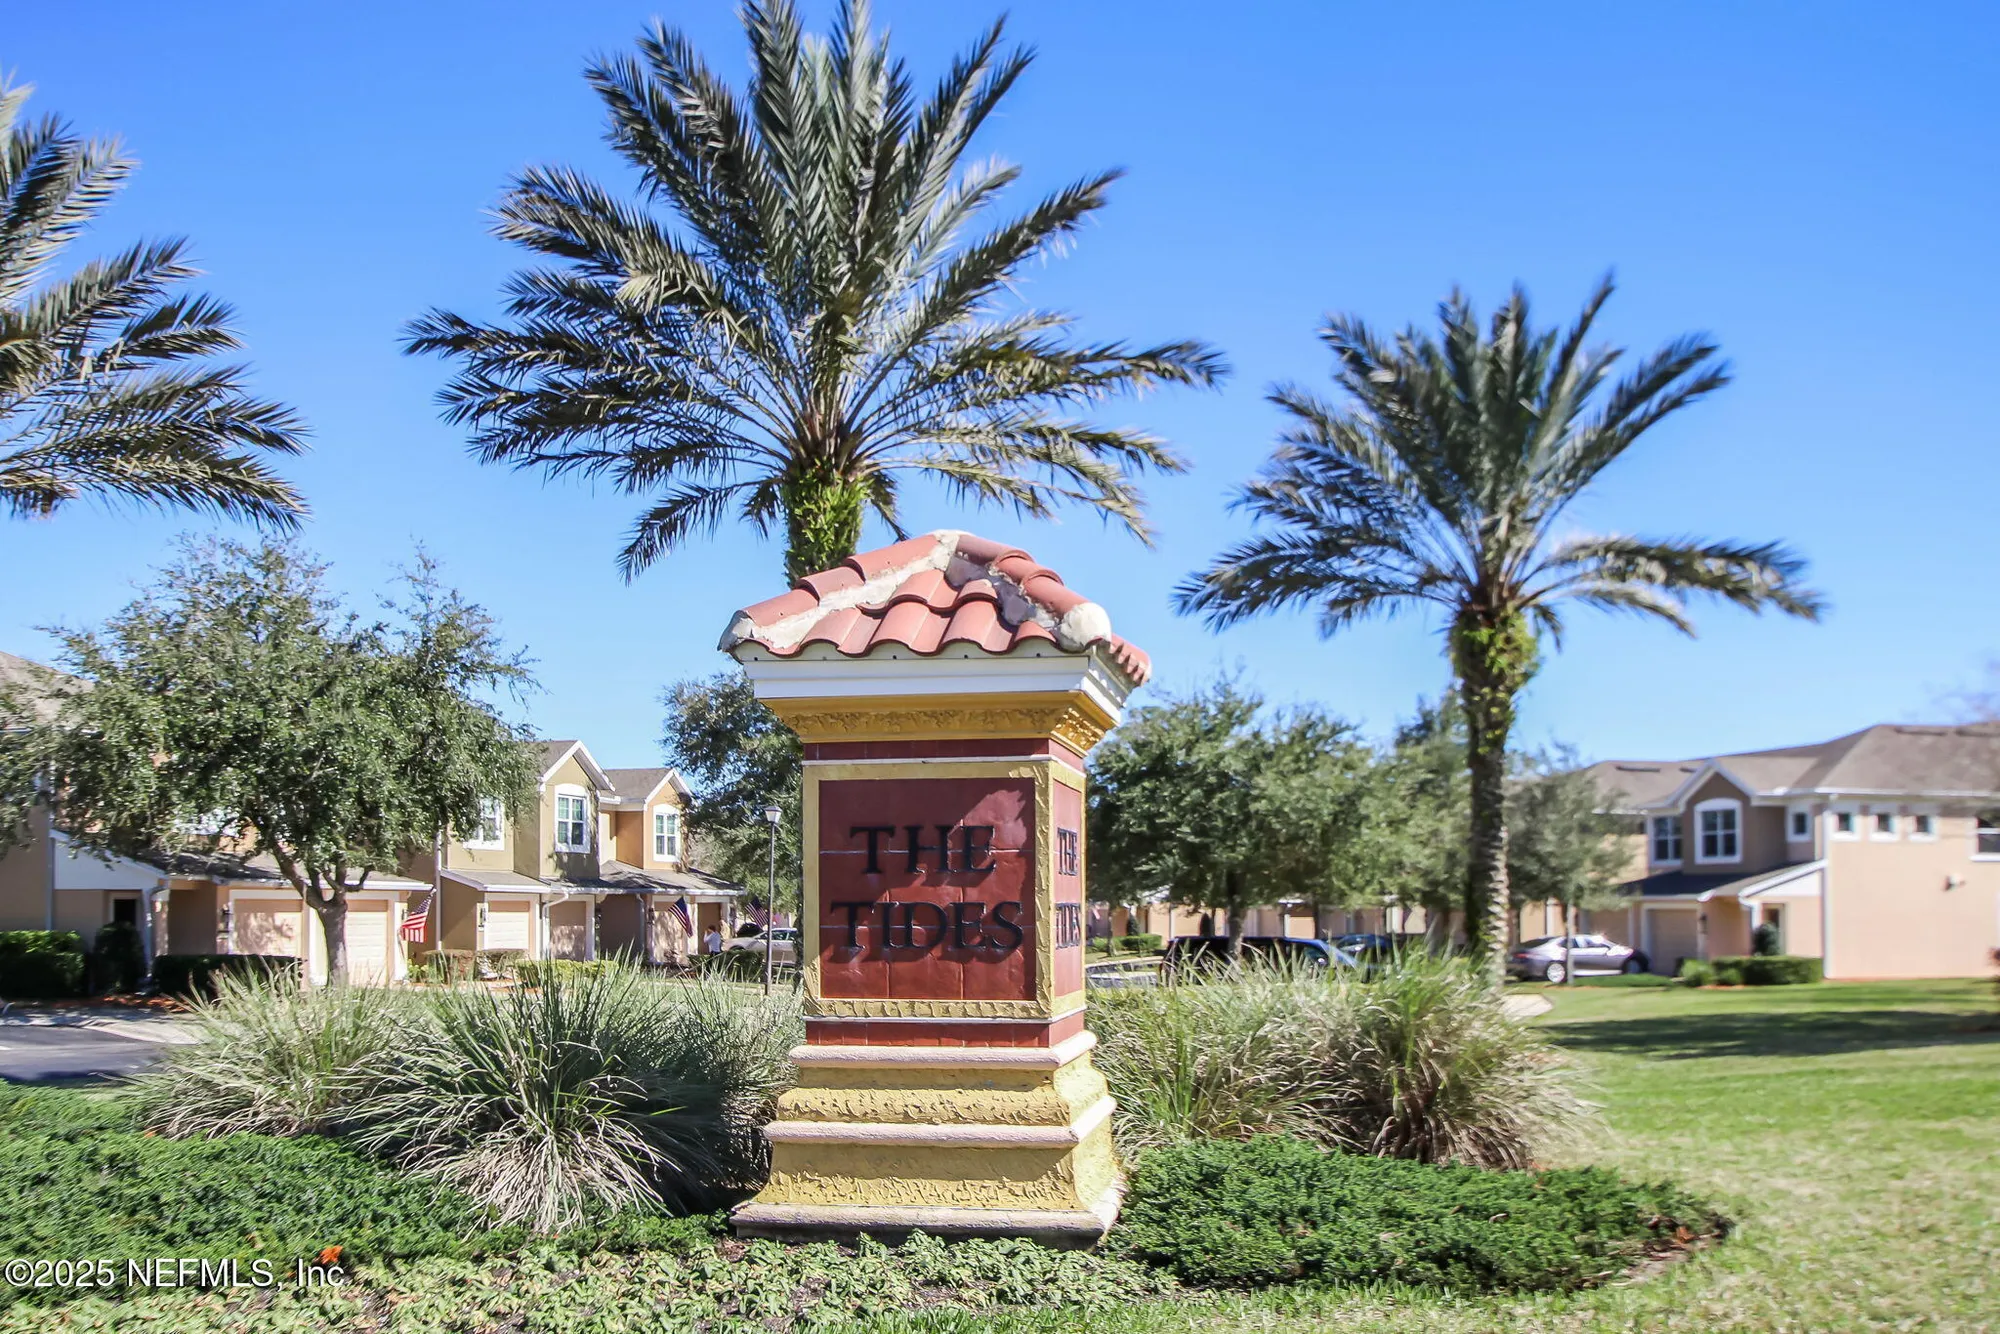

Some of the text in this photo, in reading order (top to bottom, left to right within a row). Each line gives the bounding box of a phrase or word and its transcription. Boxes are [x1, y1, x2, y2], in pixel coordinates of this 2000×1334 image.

[850, 825, 996, 875] THE
[1057, 827, 1078, 876] THE
[830, 901, 1024, 950] TIDES
